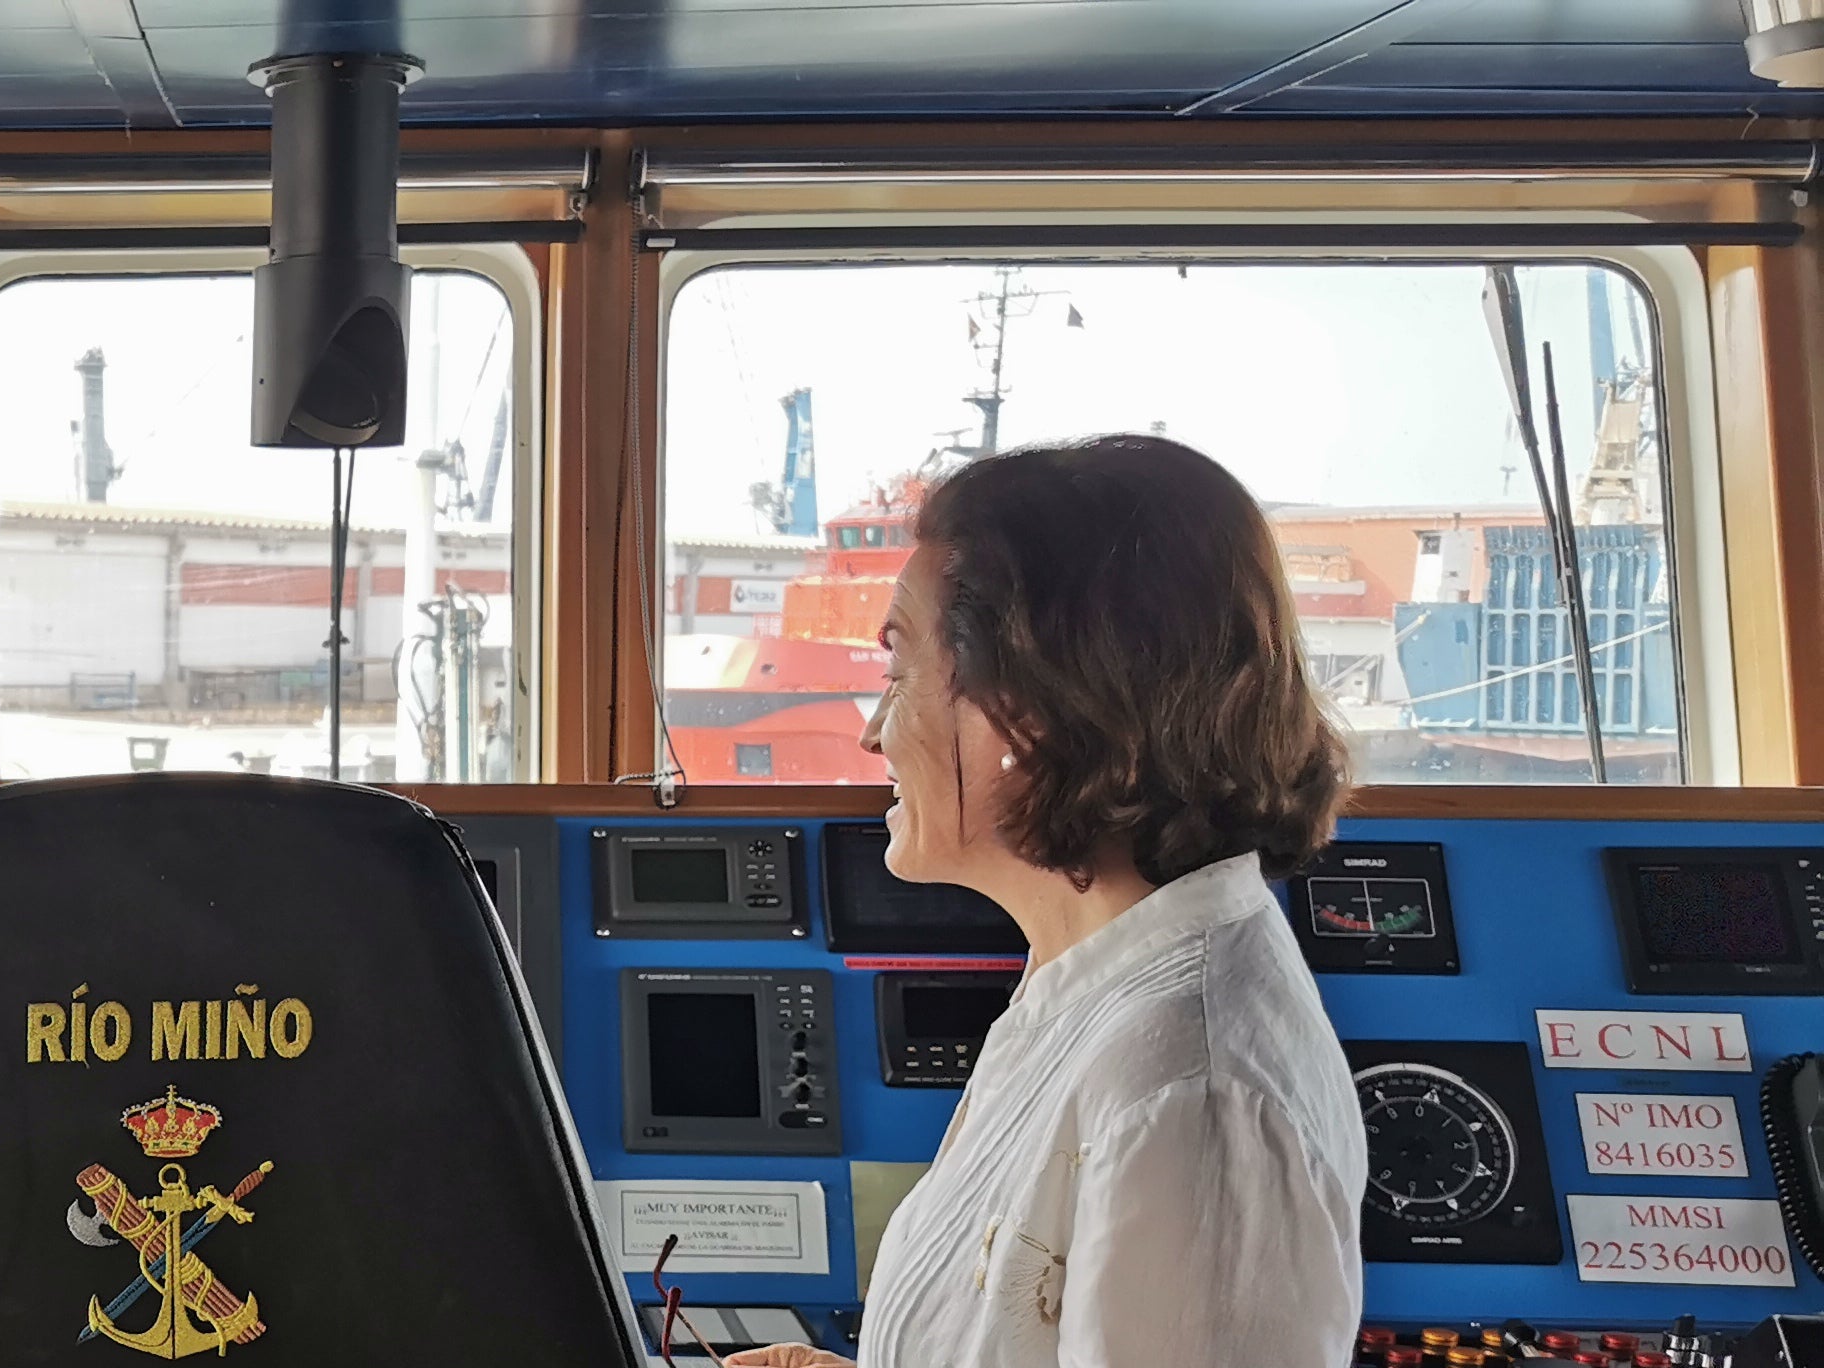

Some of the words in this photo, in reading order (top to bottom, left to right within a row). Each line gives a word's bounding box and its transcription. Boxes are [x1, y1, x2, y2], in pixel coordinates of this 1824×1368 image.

[26, 982, 132, 1065] RÍO
[150, 983, 313, 1061] MIÑO
[1593, 1102, 1634, 1128] Nº
[1647, 1103, 1723, 1130] IMO
[1596, 1141, 1736, 1170] 8416035
[1628, 1204, 1726, 1230] MMSI
[1581, 1241, 1786, 1274] 225364000
